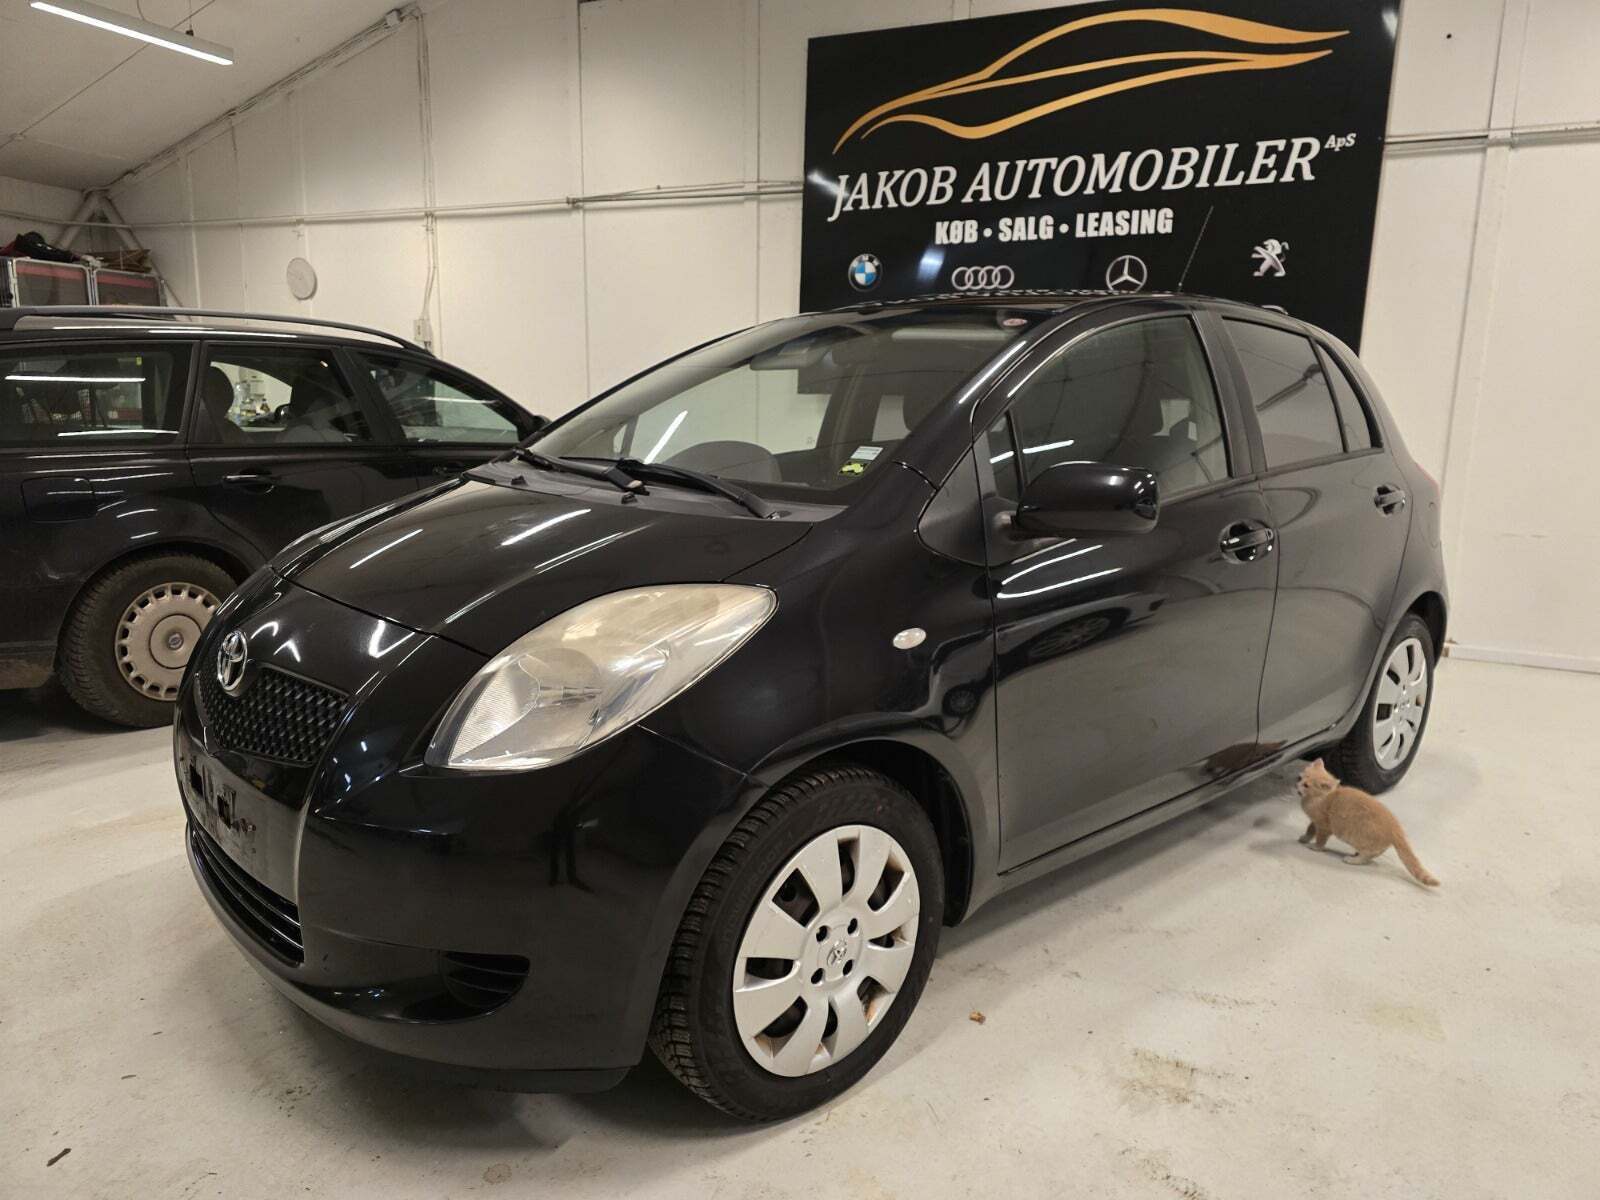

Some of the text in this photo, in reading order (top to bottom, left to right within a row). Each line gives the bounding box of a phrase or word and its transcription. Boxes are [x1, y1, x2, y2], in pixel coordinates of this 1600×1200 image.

[827, 133, 1357, 222] JAKOB AUTOMOBILER ApS
[935, 207, 1174, 245] KØB SALG LEASING
